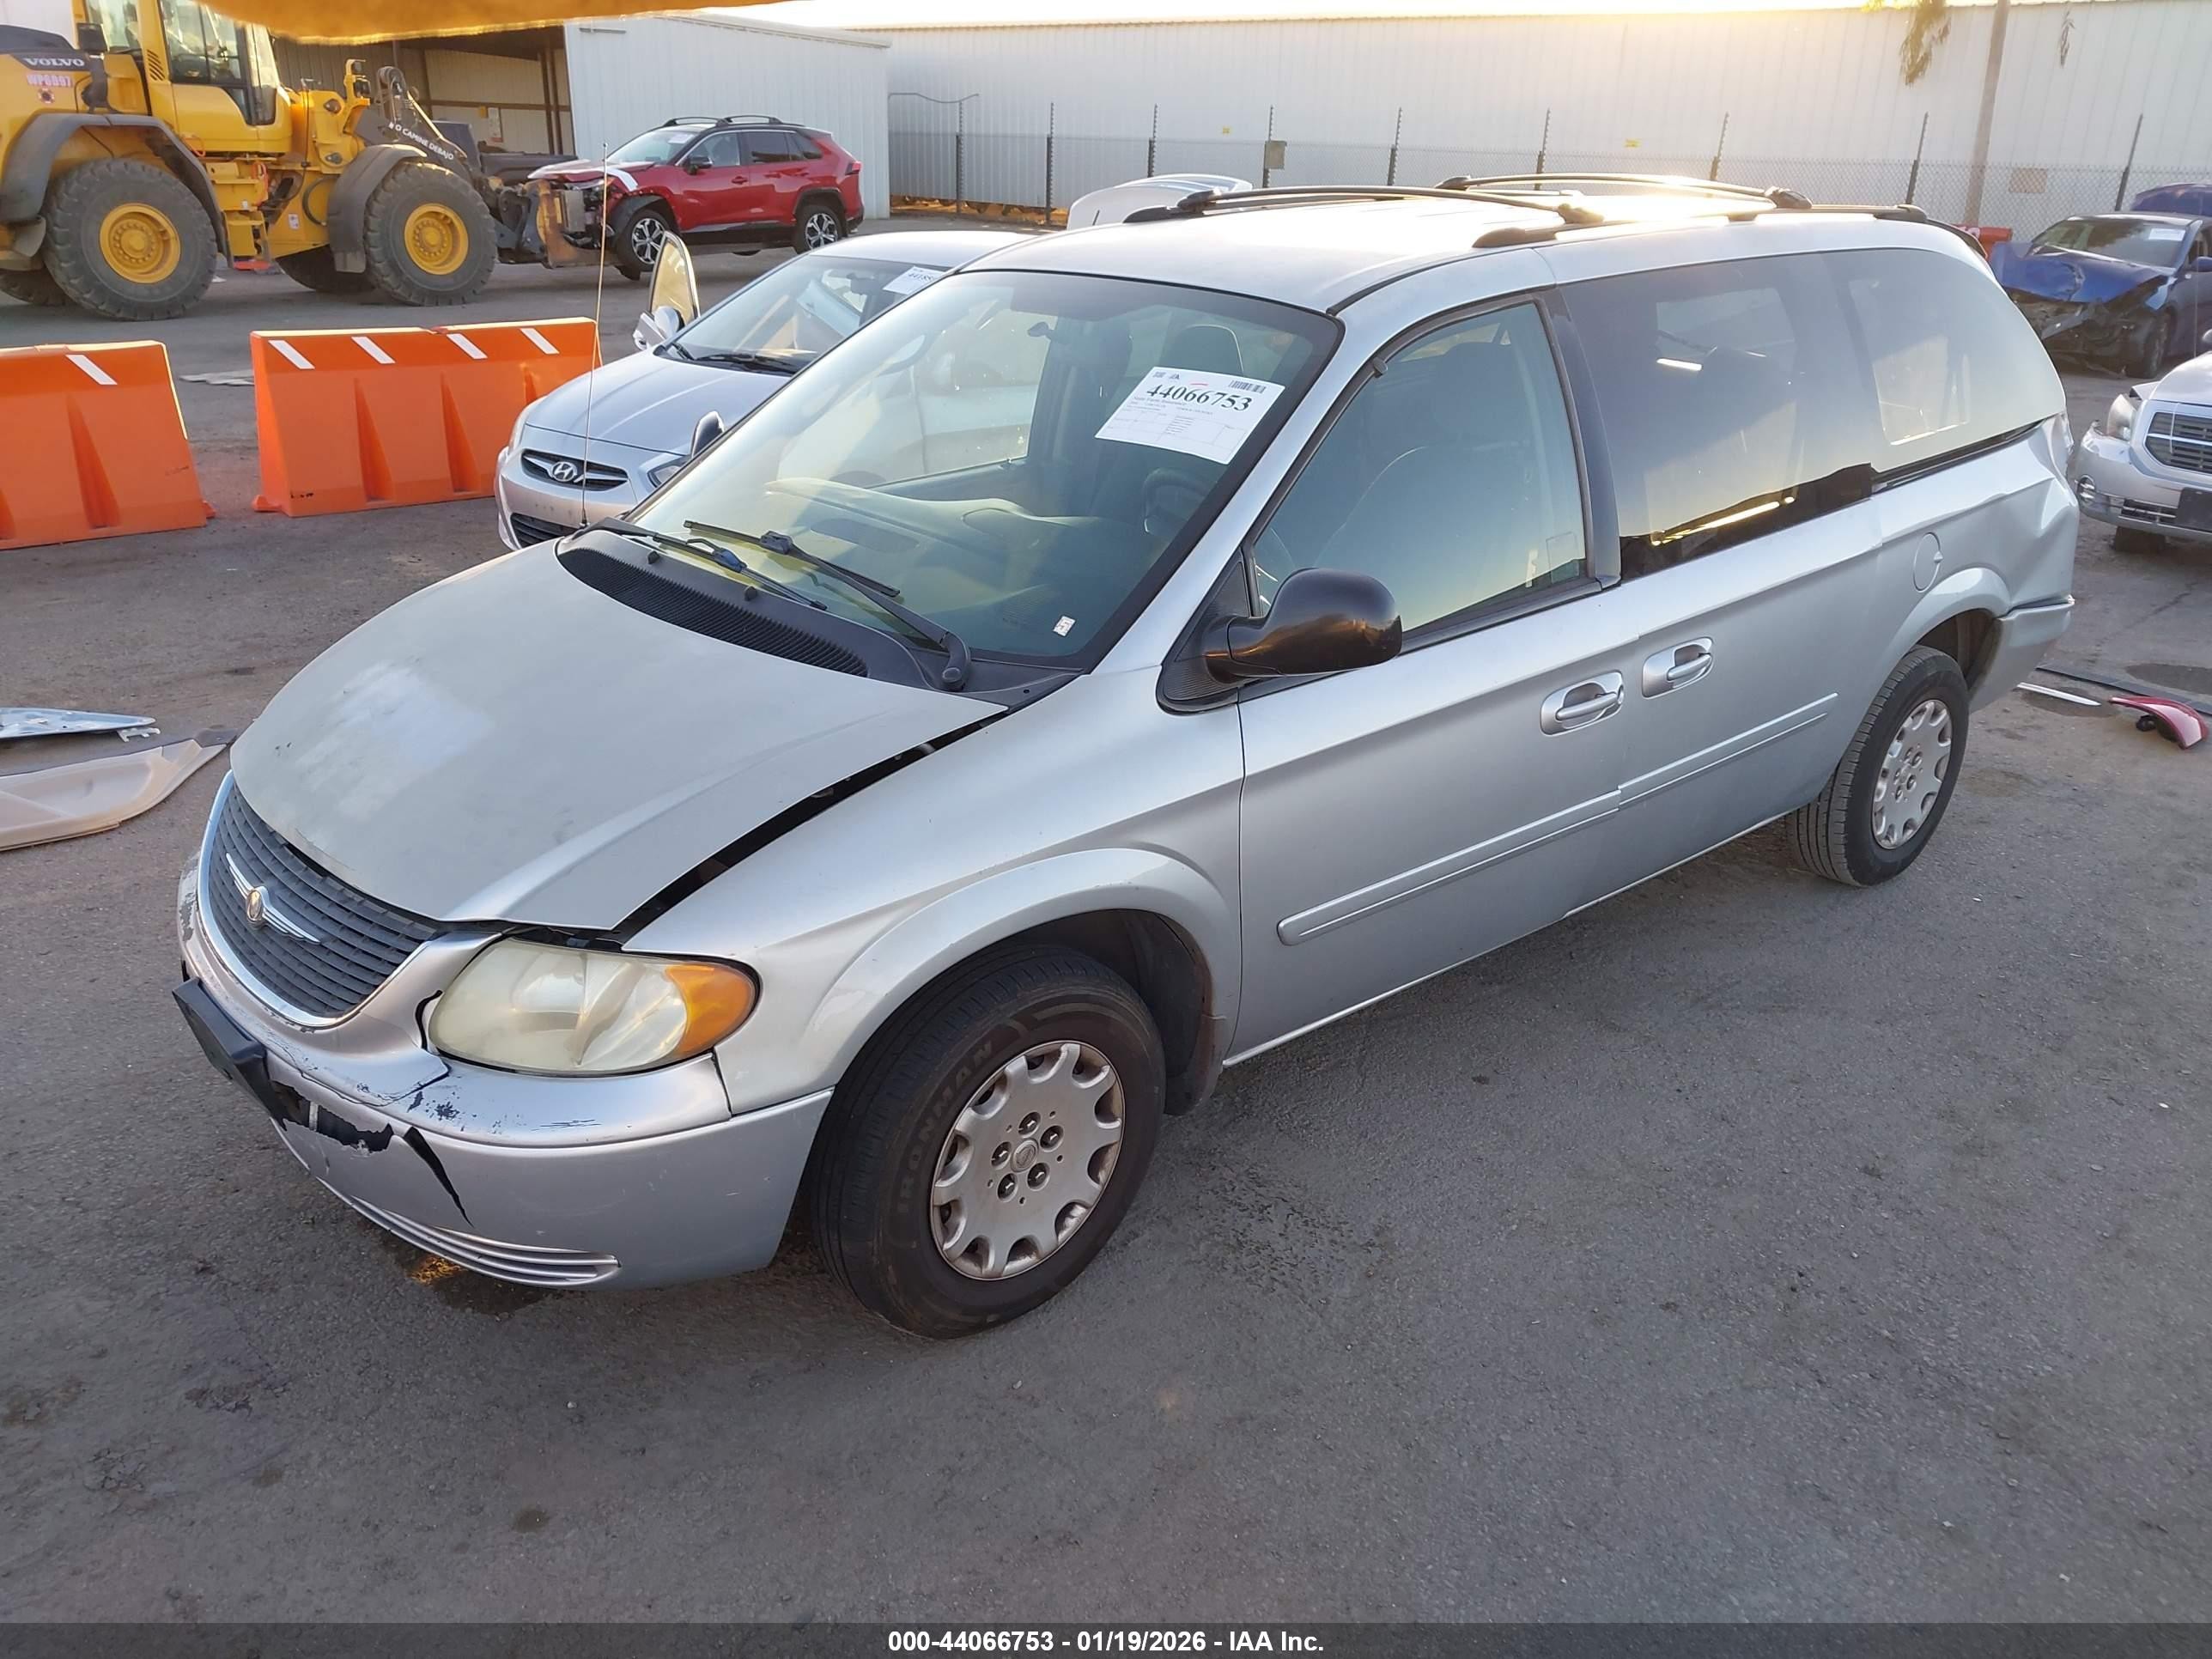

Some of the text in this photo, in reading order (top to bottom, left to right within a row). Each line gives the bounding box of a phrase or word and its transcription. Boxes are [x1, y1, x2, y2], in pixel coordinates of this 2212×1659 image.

[23, 58, 85, 67] VOLVO
[402, 128, 428, 148] CAMINE
[428, 143, 454, 161] DEBAJO
[1146, 384, 1252, 411] 44066753
